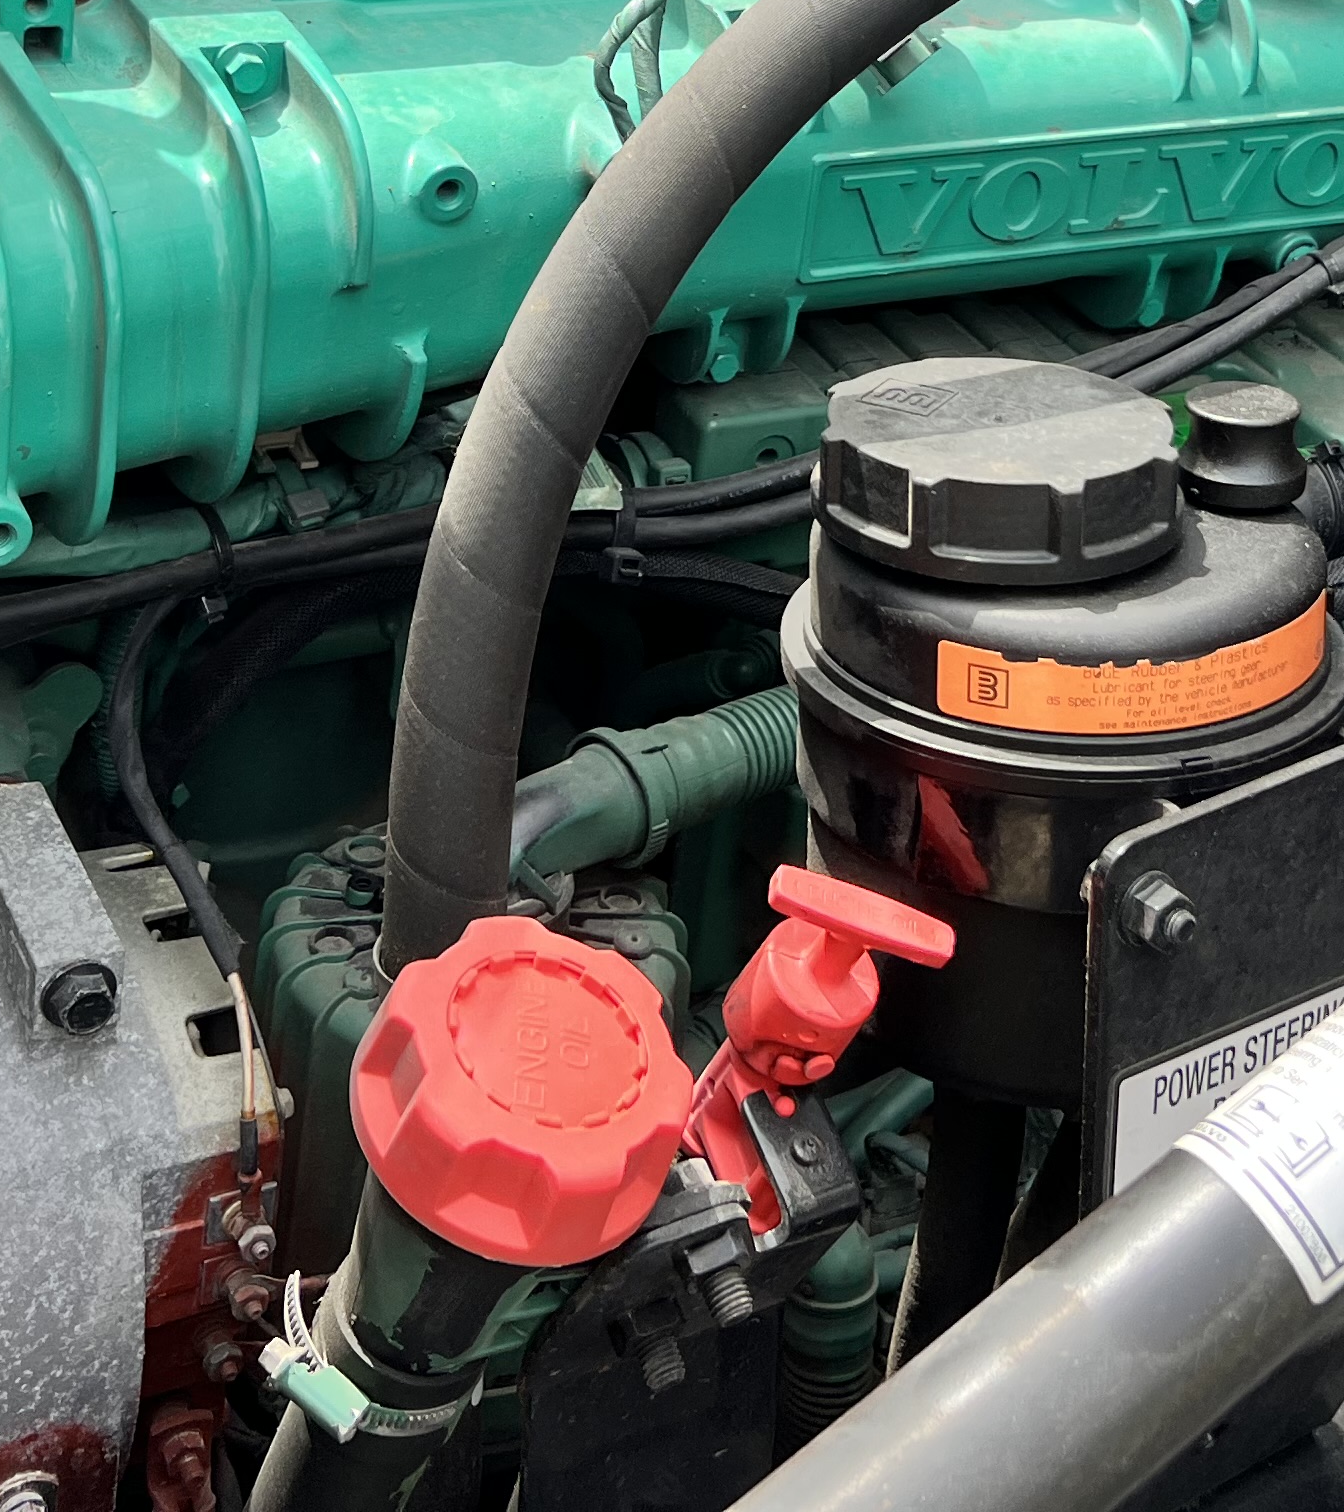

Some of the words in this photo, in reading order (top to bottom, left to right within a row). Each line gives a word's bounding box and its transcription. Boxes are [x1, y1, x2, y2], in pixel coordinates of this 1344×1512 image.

[1092, 680, 1155, 694] Lubricant
[1164, 677, 1182, 689] for
[1188, 667, 1237, 687] steering
[1240, 660, 1262, 678] gear
[1131, 663, 1184, 678] Rubber
[1210, 641, 1269, 667] Plastics
[1046, 696, 1061, 706] as
[1068, 695, 1132, 708] specified
[1138, 694, 1152, 708] by
[1159, 692, 1179, 704] the
[1185, 682, 1227, 700] vehicle
[1232, 660, 1289, 689] manufacturer
[1099, 721, 1117, 730] see
[1123, 717, 1187, 730] maintenance
[1194, 700, 1253, 720] instructions
[1126, 708, 1142, 718] For
[1174, 704, 1200, 714] level
[1206, 696, 1232, 709] check
[514, 977, 550, 1111] ENGINE
[559, 1016, 592, 1070] OIL
[1153, 1045, 1236, 1115] POWER
